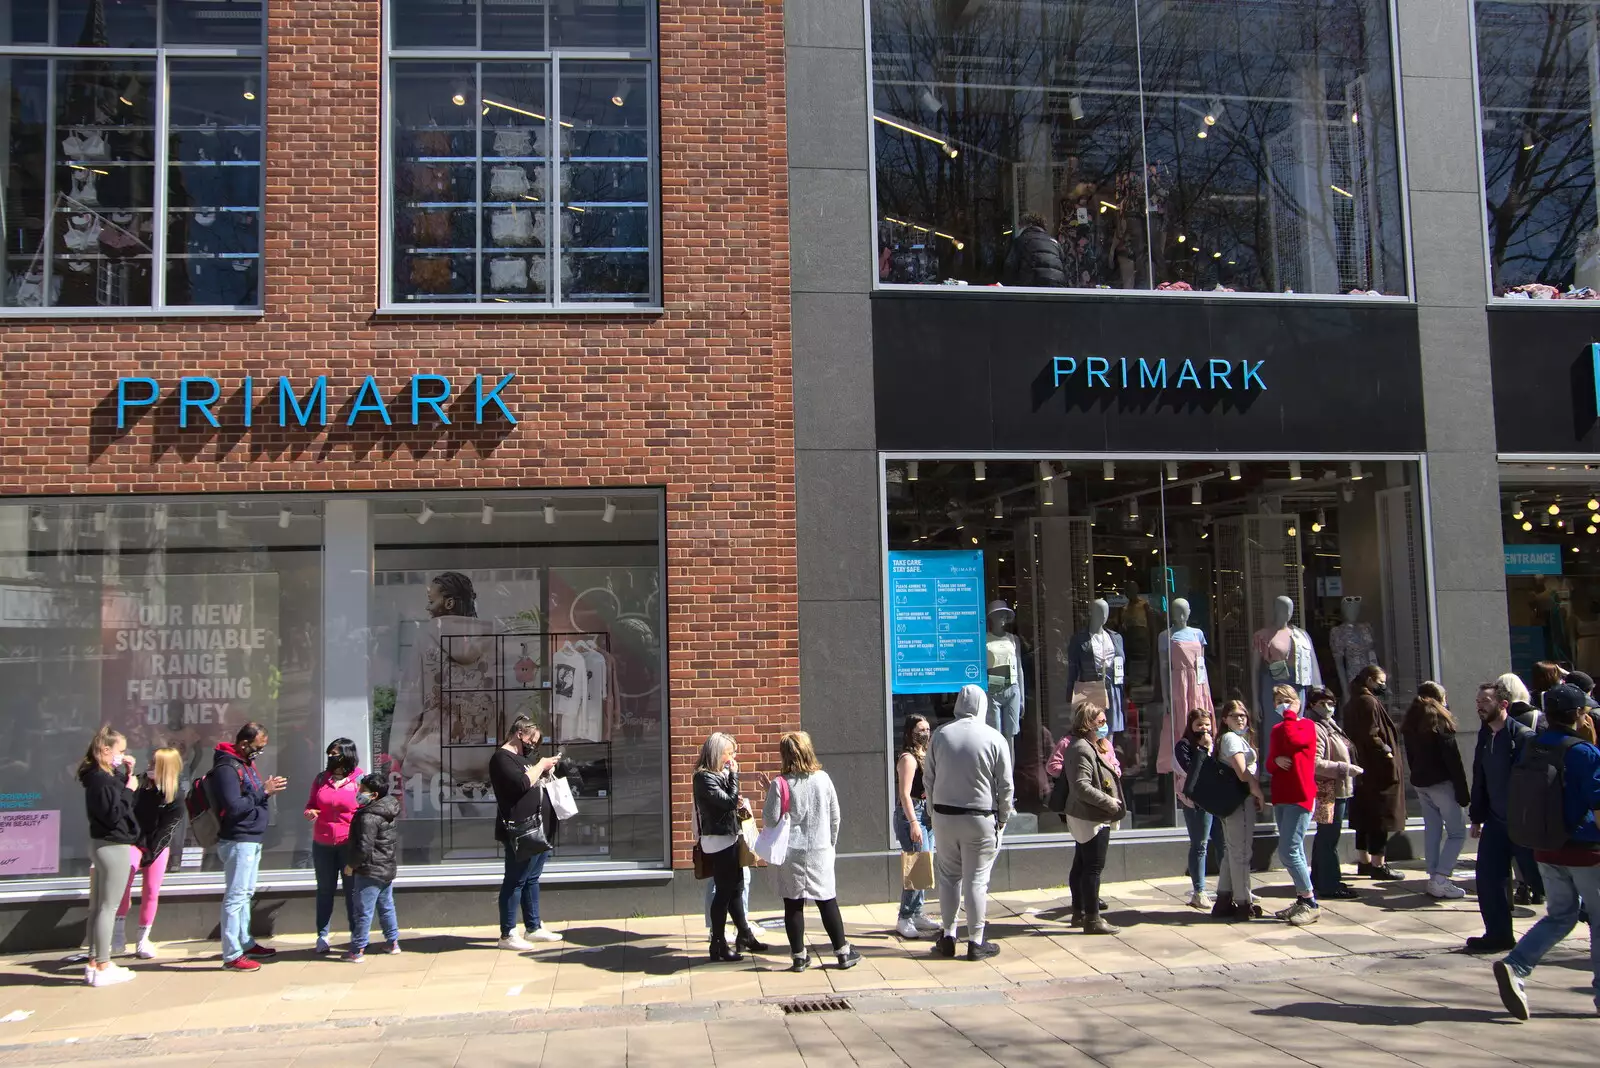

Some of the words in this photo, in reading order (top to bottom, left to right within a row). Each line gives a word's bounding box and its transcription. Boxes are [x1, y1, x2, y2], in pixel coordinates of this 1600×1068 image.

[1053, 356, 1268, 390] PRIMARK
[116, 372, 518, 429] PRIMARK
[1505, 552, 1556, 564] ENTRANCE
[140, 604, 183, 626] OUR
[192, 604, 243, 625] NEW
[115, 628, 265, 651] SUSTAINABLE
[152, 653, 228, 675] RANGE
[127, 677, 252, 701] FEATURING
[147, 703, 229, 725] DINEY
